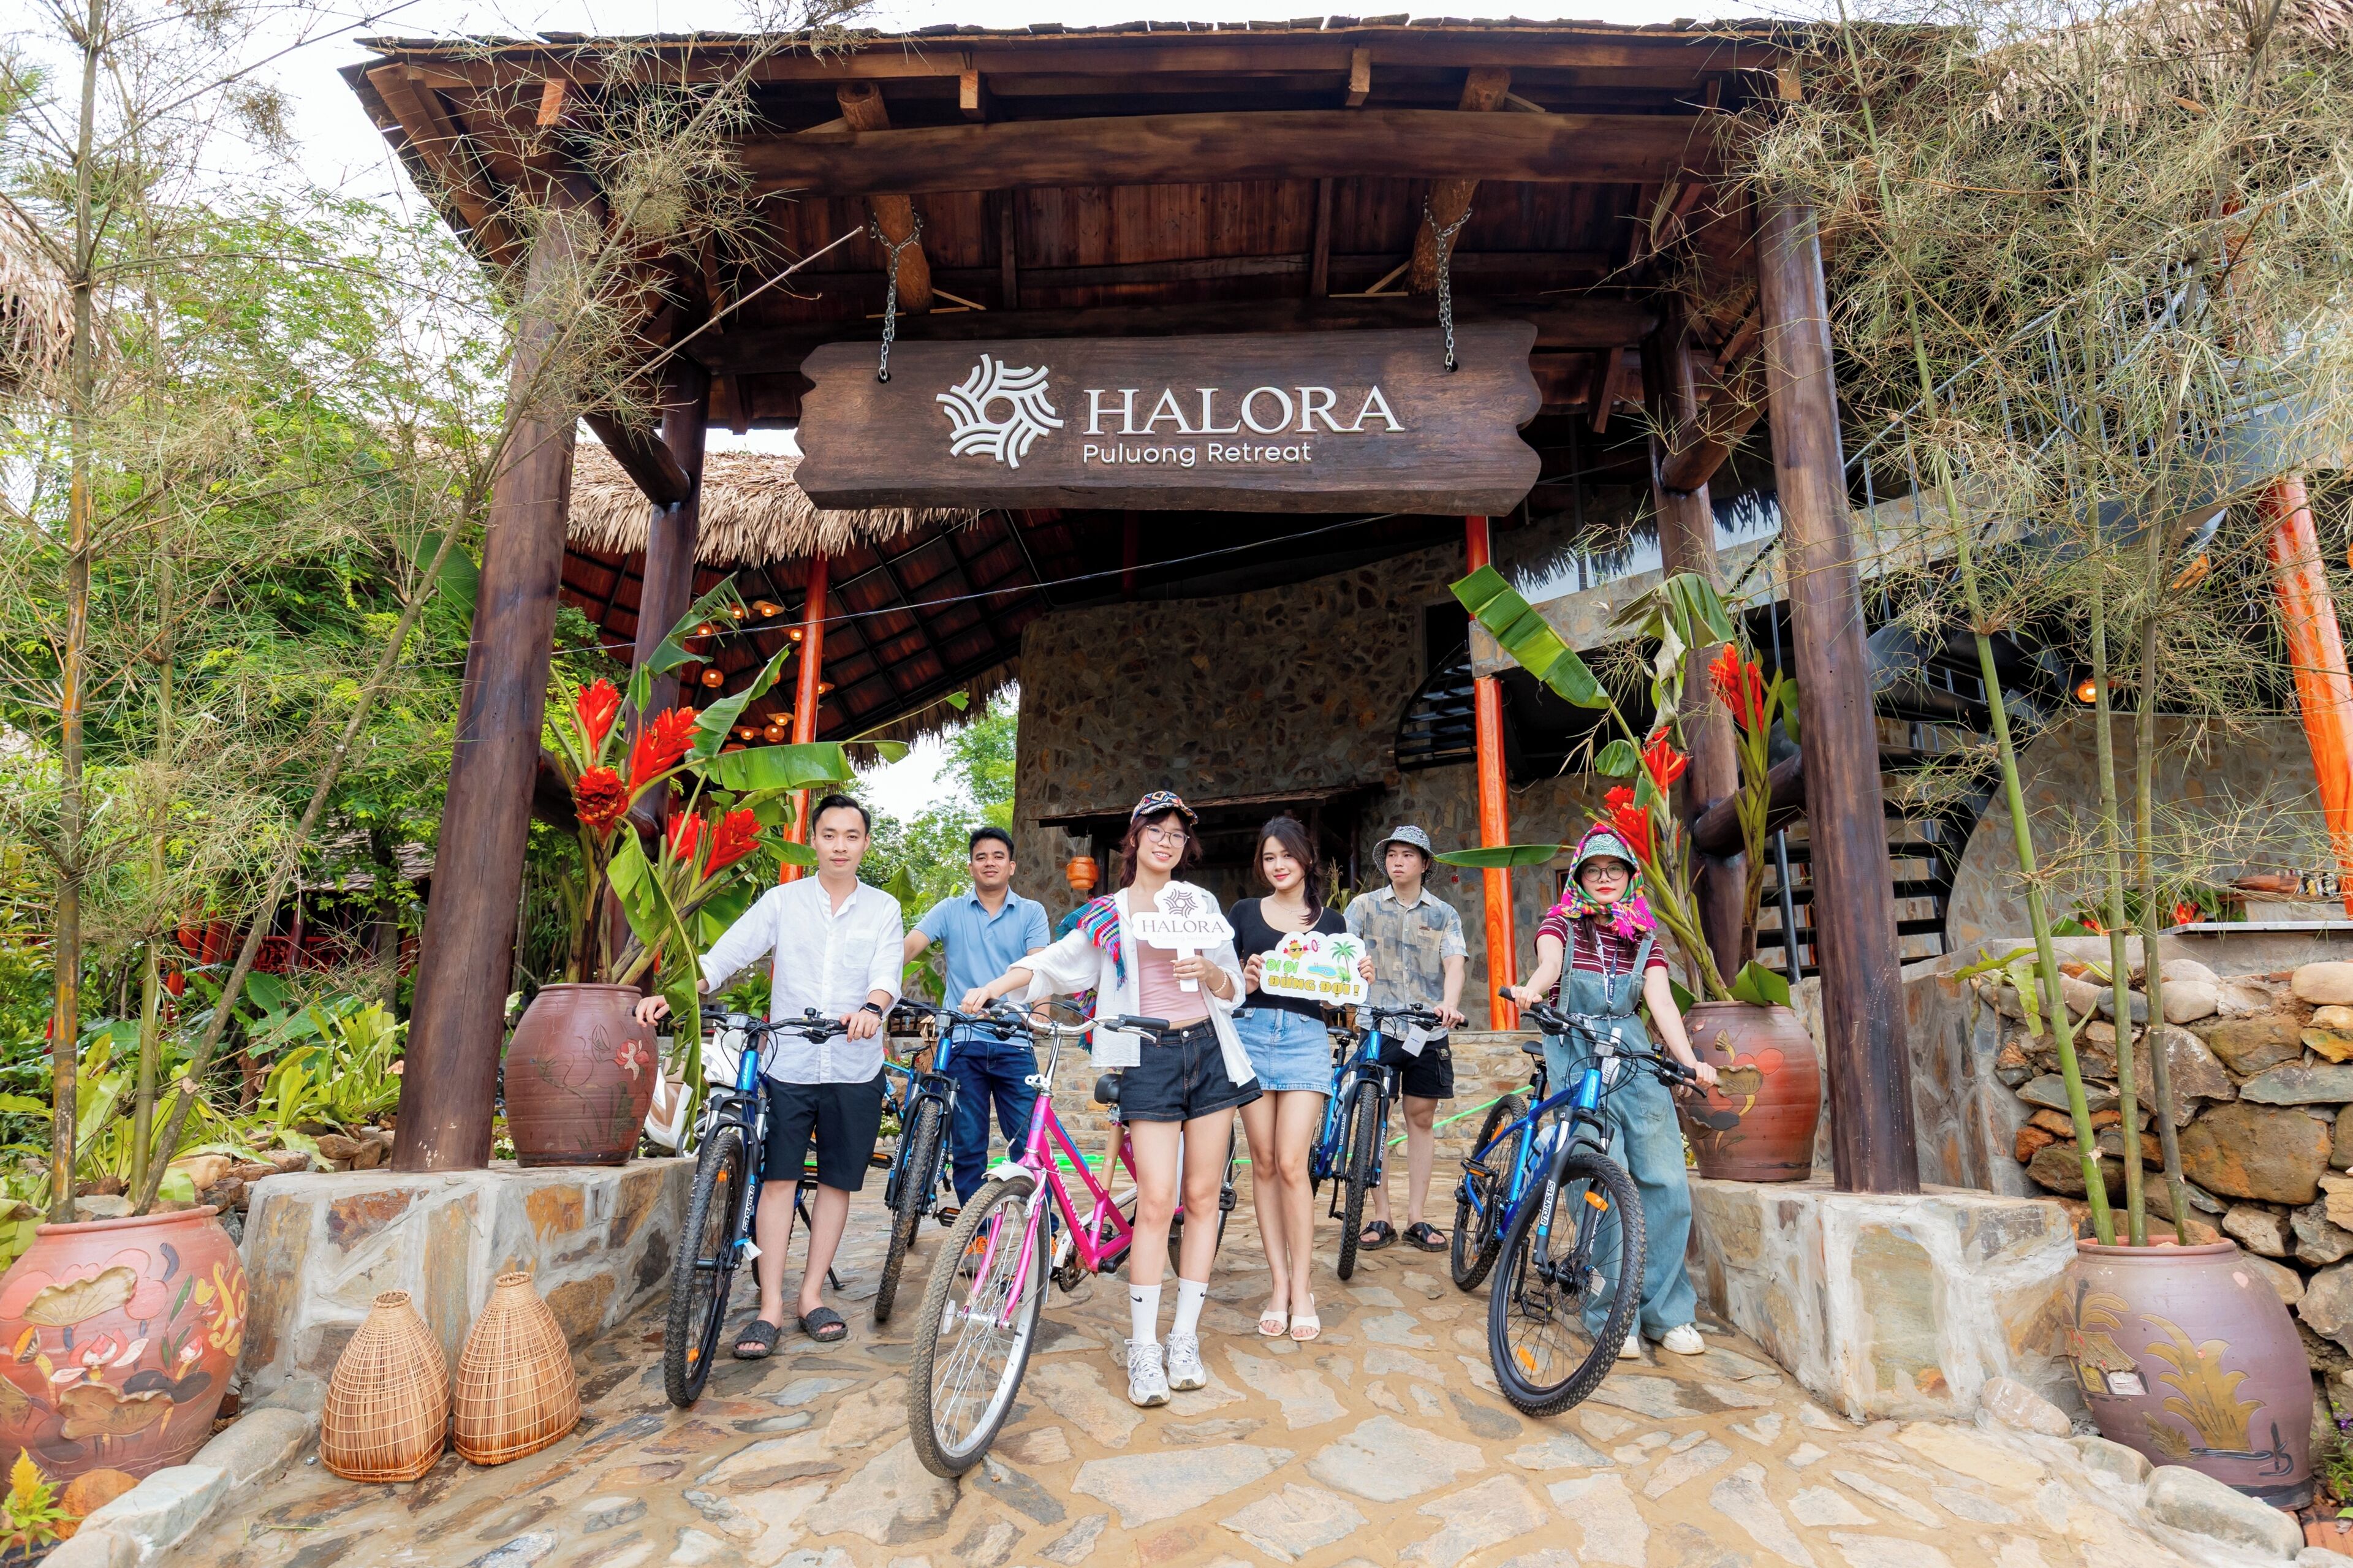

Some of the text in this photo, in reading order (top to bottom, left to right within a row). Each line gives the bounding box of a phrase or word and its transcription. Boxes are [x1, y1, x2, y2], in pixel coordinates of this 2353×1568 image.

[1083, 385, 1405, 436] HALORA
[1083, 441, 1312, 468] Puluong Retreat
[1142, 920, 1225, 933] HALORA
[1265, 958, 1299, 974] ĐI ĐI
[1540, 1179, 1556, 1225] SR SUNTOUR
